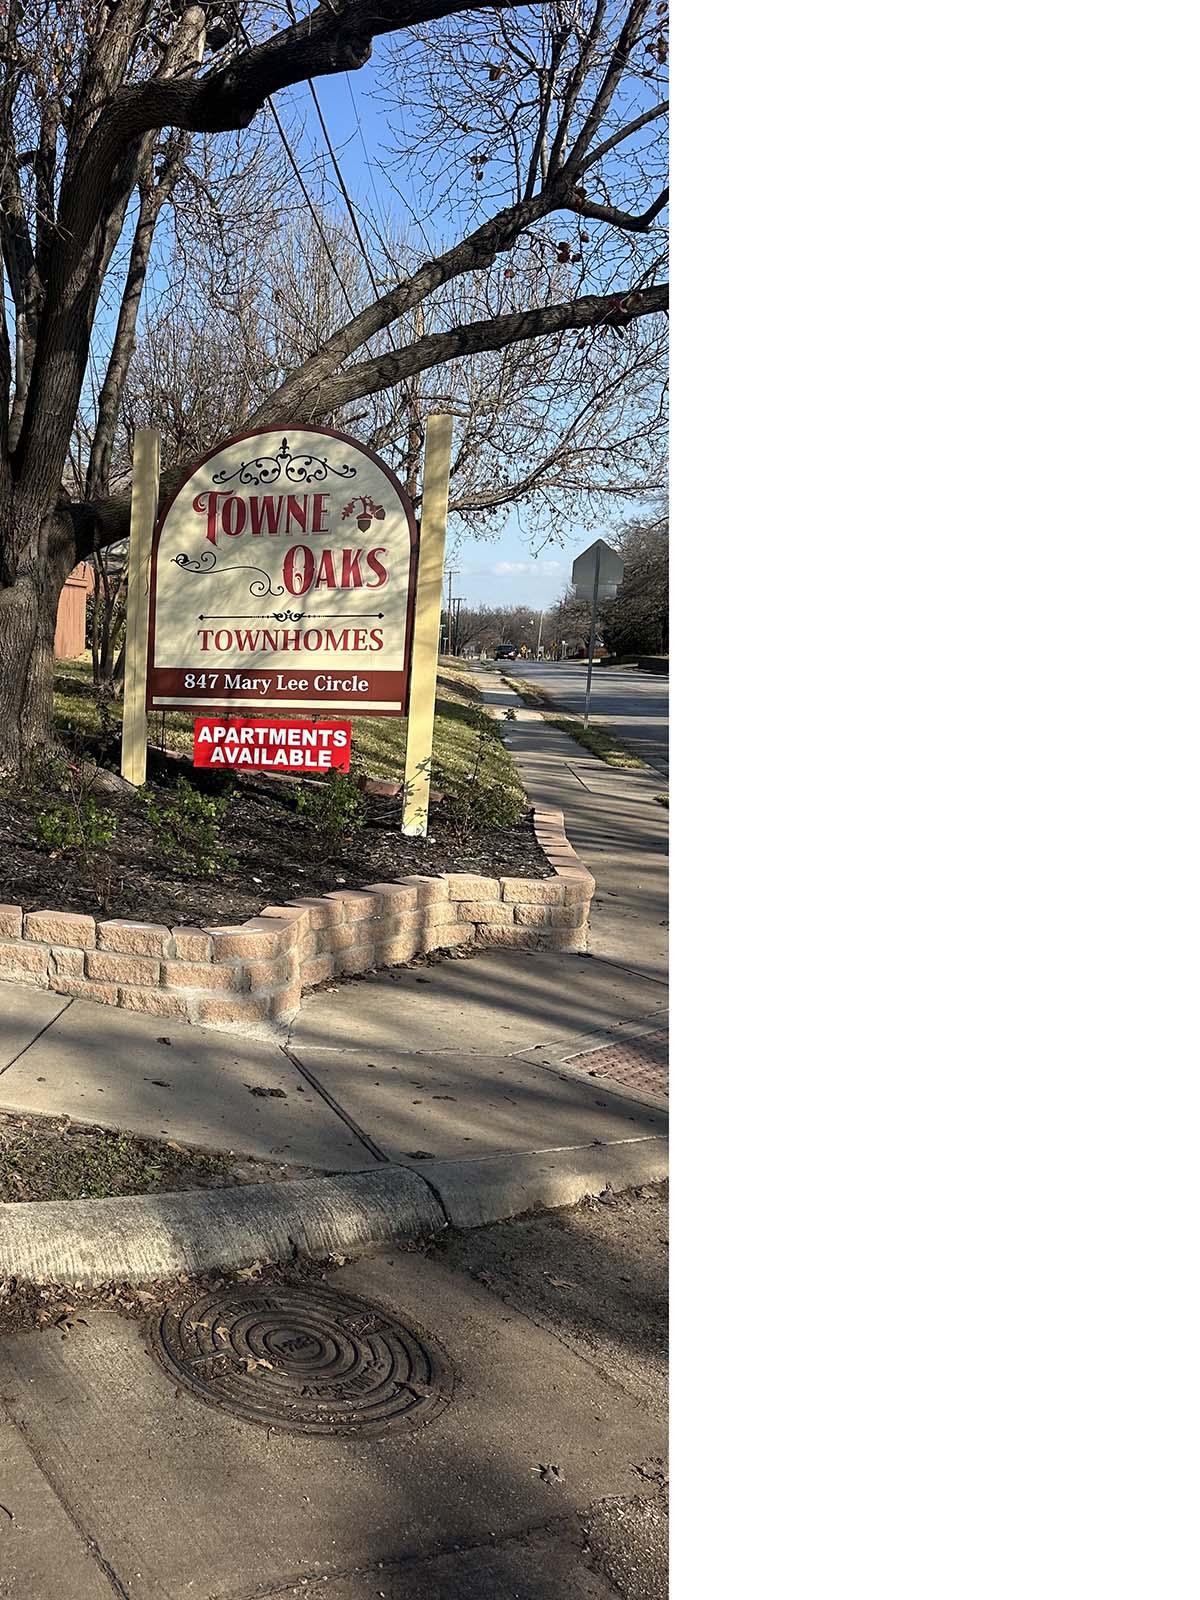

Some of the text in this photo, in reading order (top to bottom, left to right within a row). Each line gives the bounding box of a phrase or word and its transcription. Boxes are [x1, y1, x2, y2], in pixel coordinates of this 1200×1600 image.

[192, 490, 331, 547] TOWNE
[283, 544, 389, 597] OAKS
[198, 628, 384, 651] TOWNHOMES
[184, 674, 369, 694] 847 Mary Lee Circle
[198, 726, 347, 747] APARTMENTS
[210, 747, 332, 767] AVAILABLE
